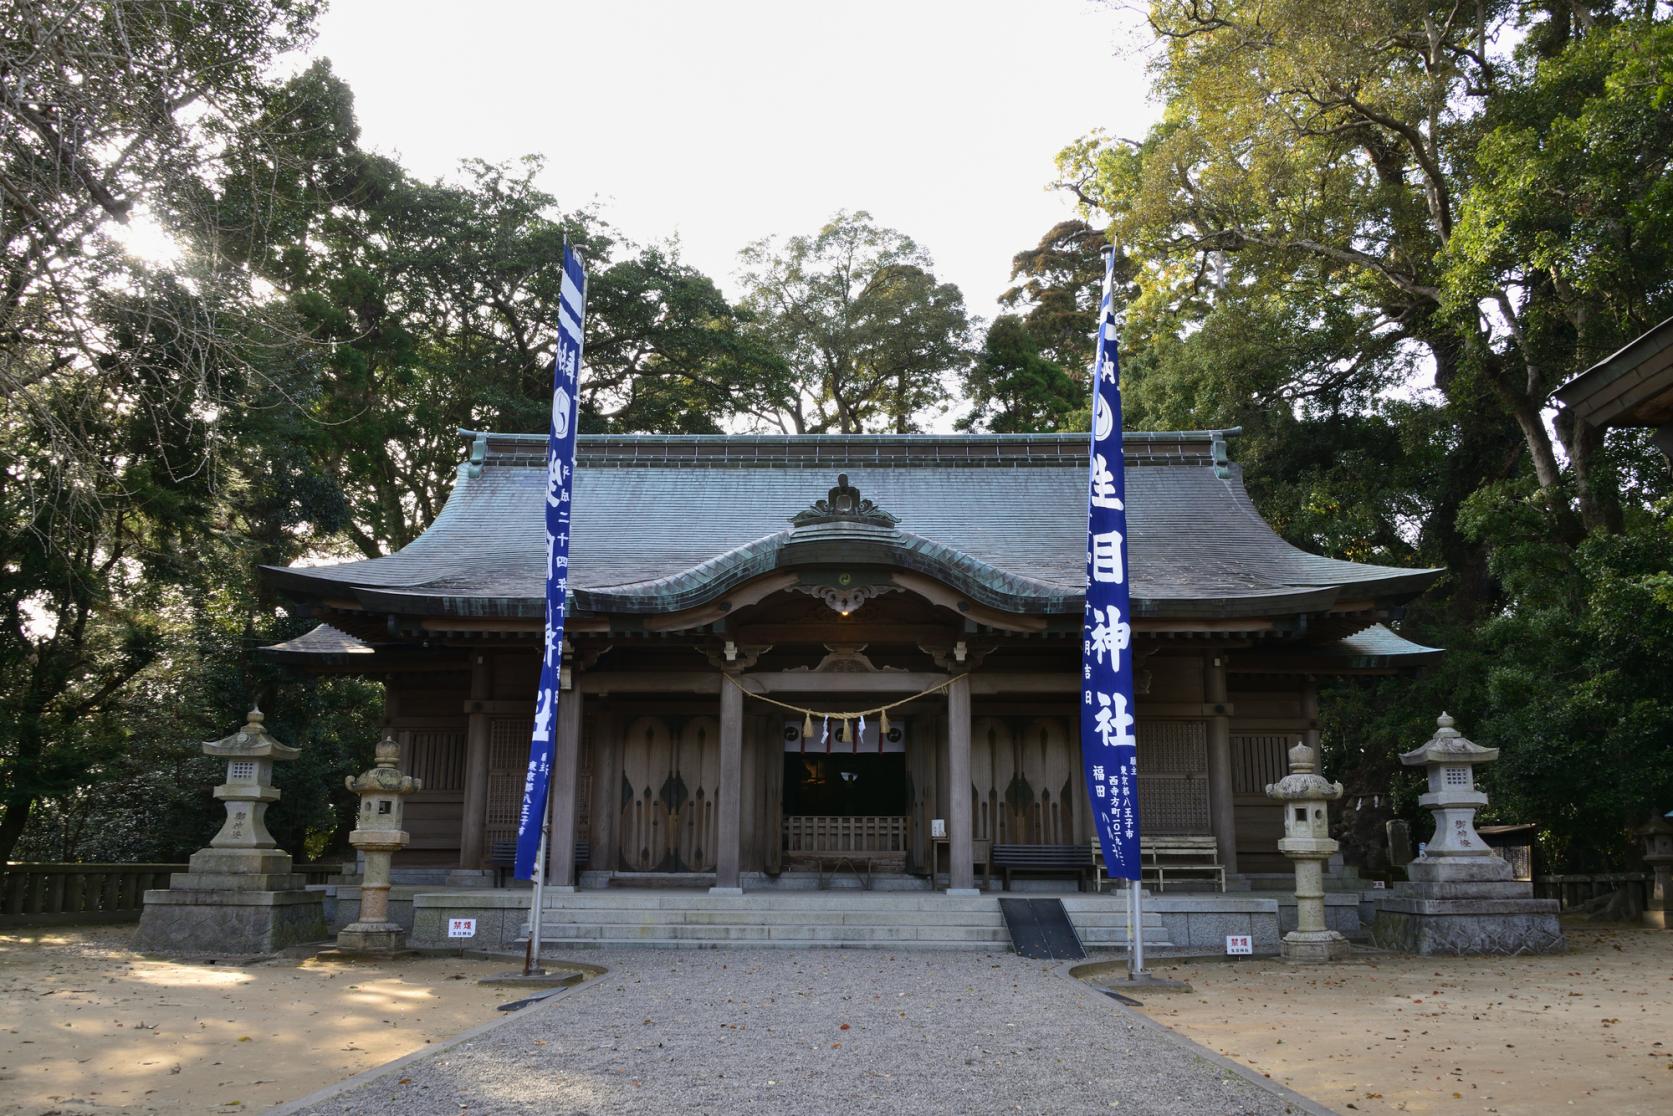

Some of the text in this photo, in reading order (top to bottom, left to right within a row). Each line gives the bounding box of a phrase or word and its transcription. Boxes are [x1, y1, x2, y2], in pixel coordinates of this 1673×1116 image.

[1091, 453, 1137, 747] 生目神社
[1120, 765, 1134, 840] 東京都八王子市
